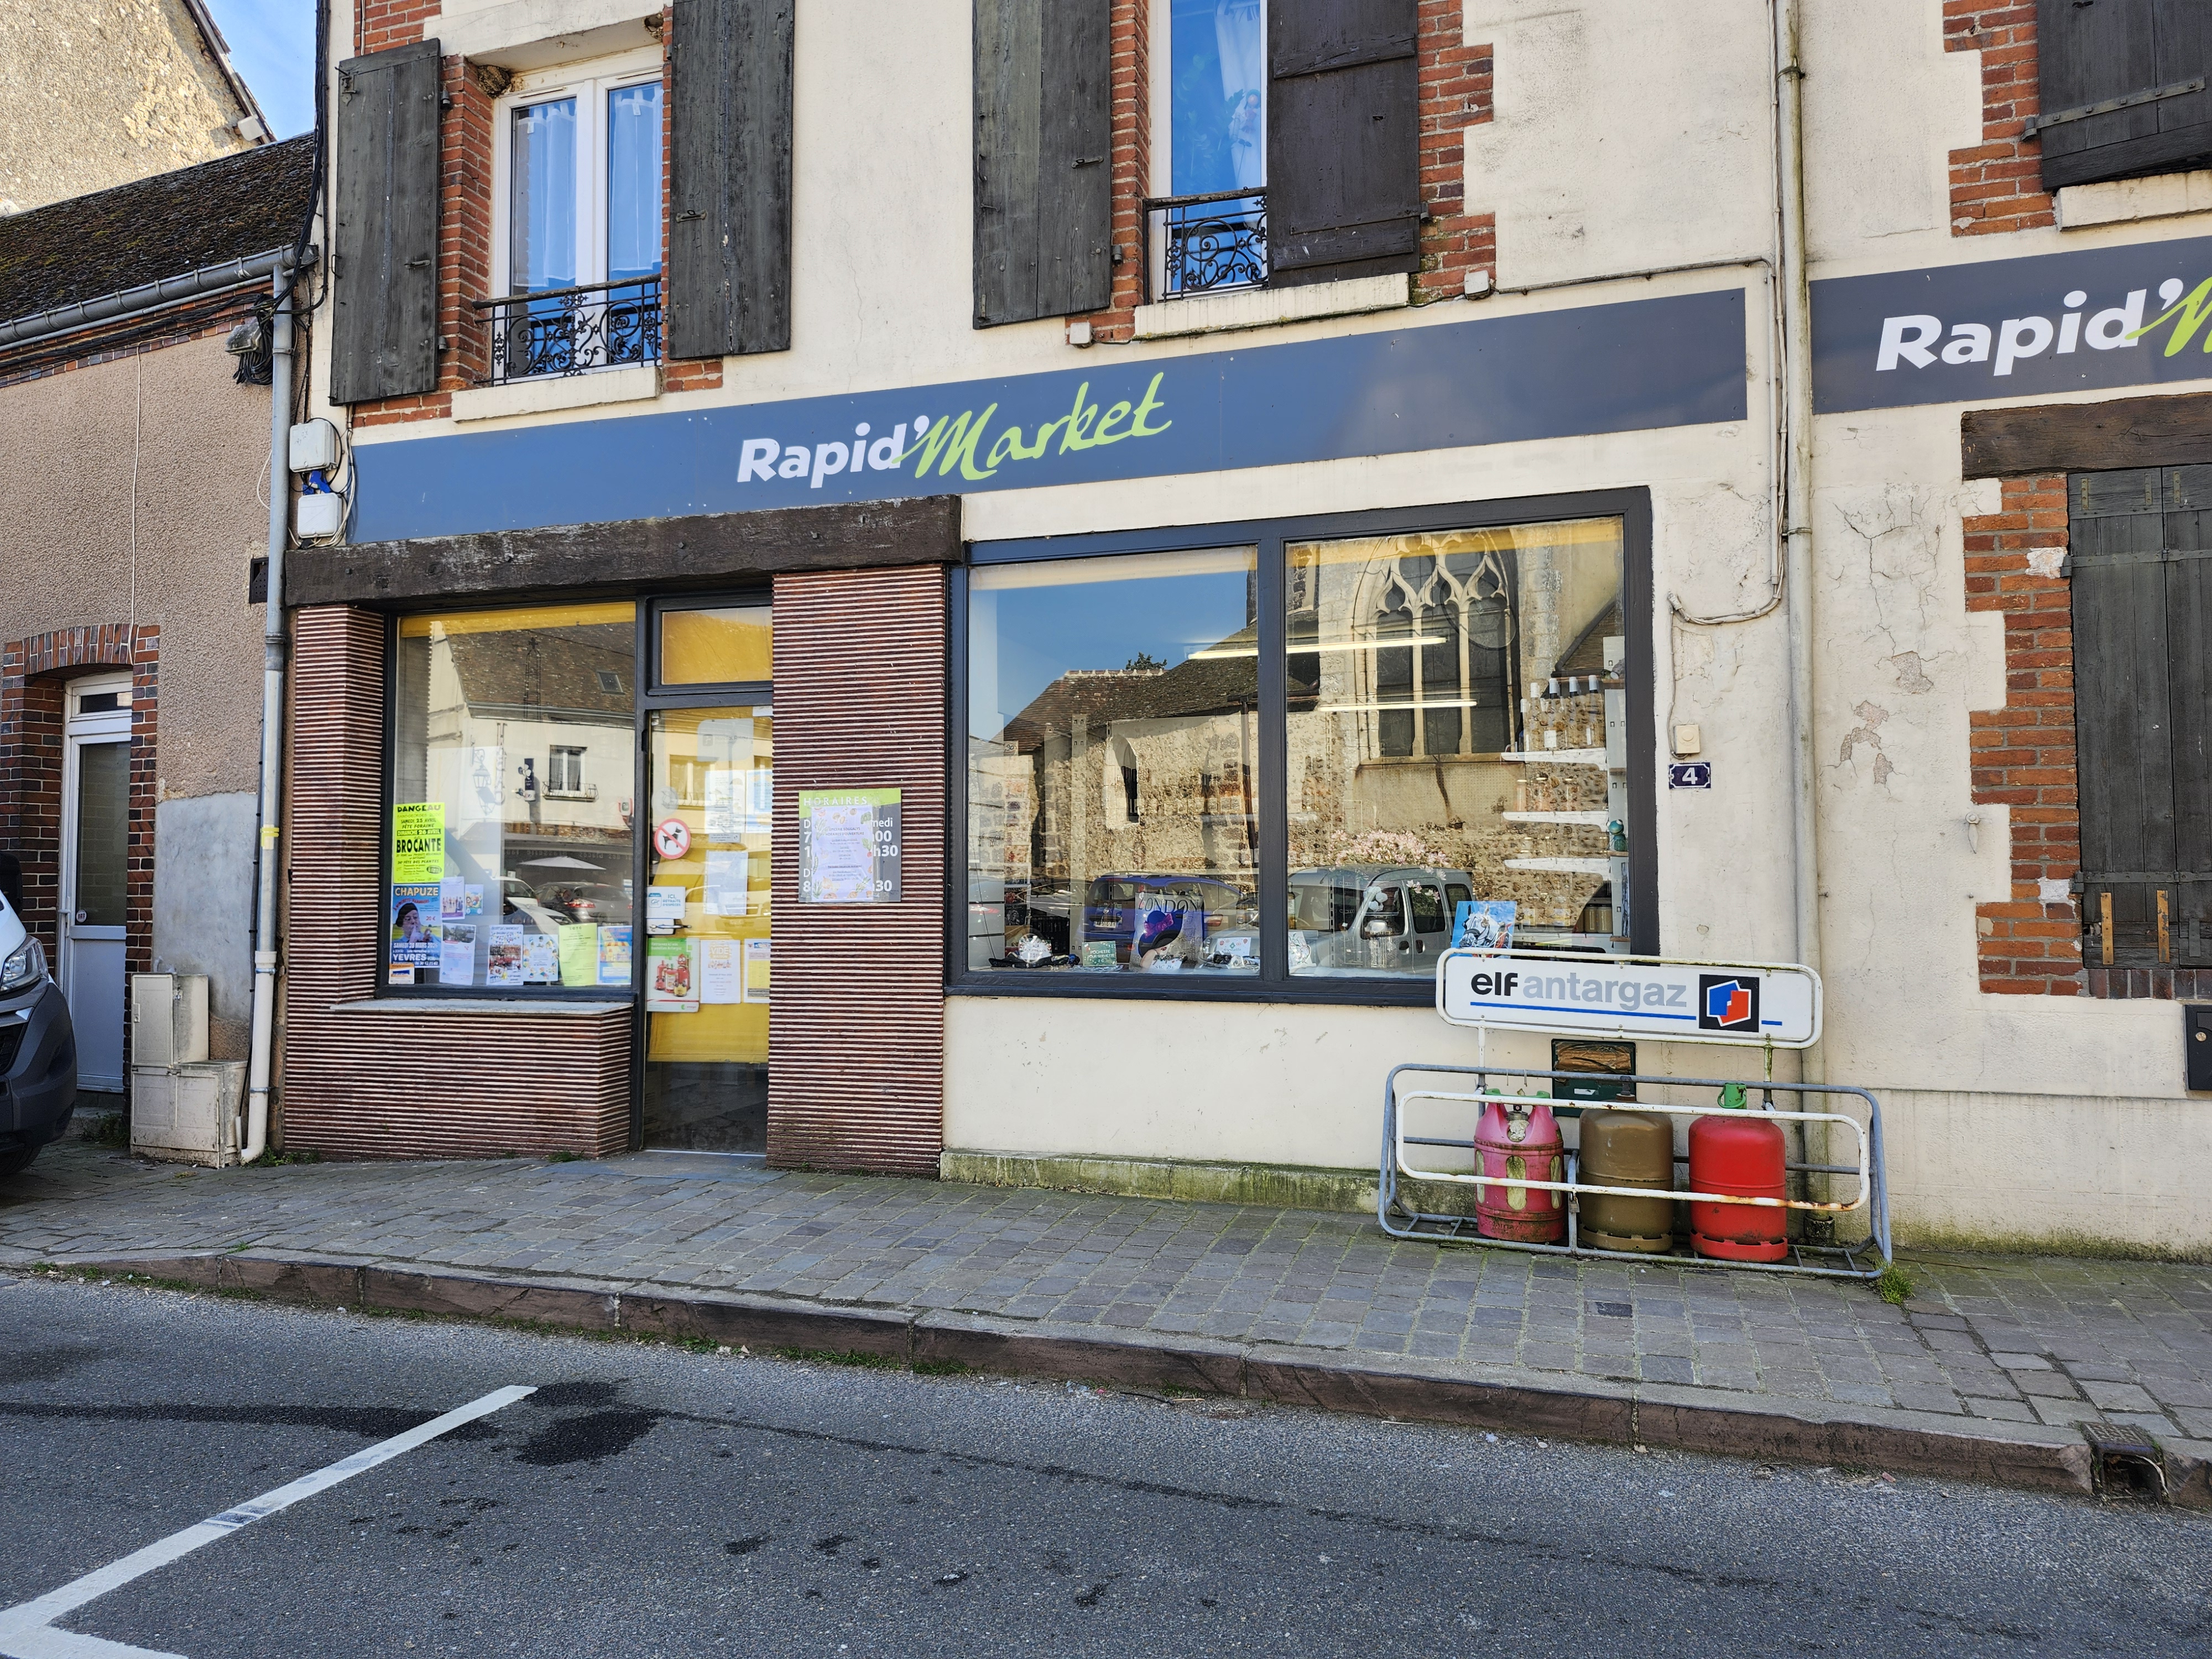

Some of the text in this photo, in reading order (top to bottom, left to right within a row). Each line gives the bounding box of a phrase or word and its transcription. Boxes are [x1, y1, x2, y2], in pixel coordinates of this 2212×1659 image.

[1682, 767, 1698, 785] 4
[804, 796, 868, 806] HORAIRES
[872, 817, 893, 828] medi
[396, 838, 441, 853] BROCANTE
[395, 887, 439, 896] CHAPUZE
[1138, 897, 1199, 914] LONDON
[1470, 971, 1687, 1011] elf antargaz
